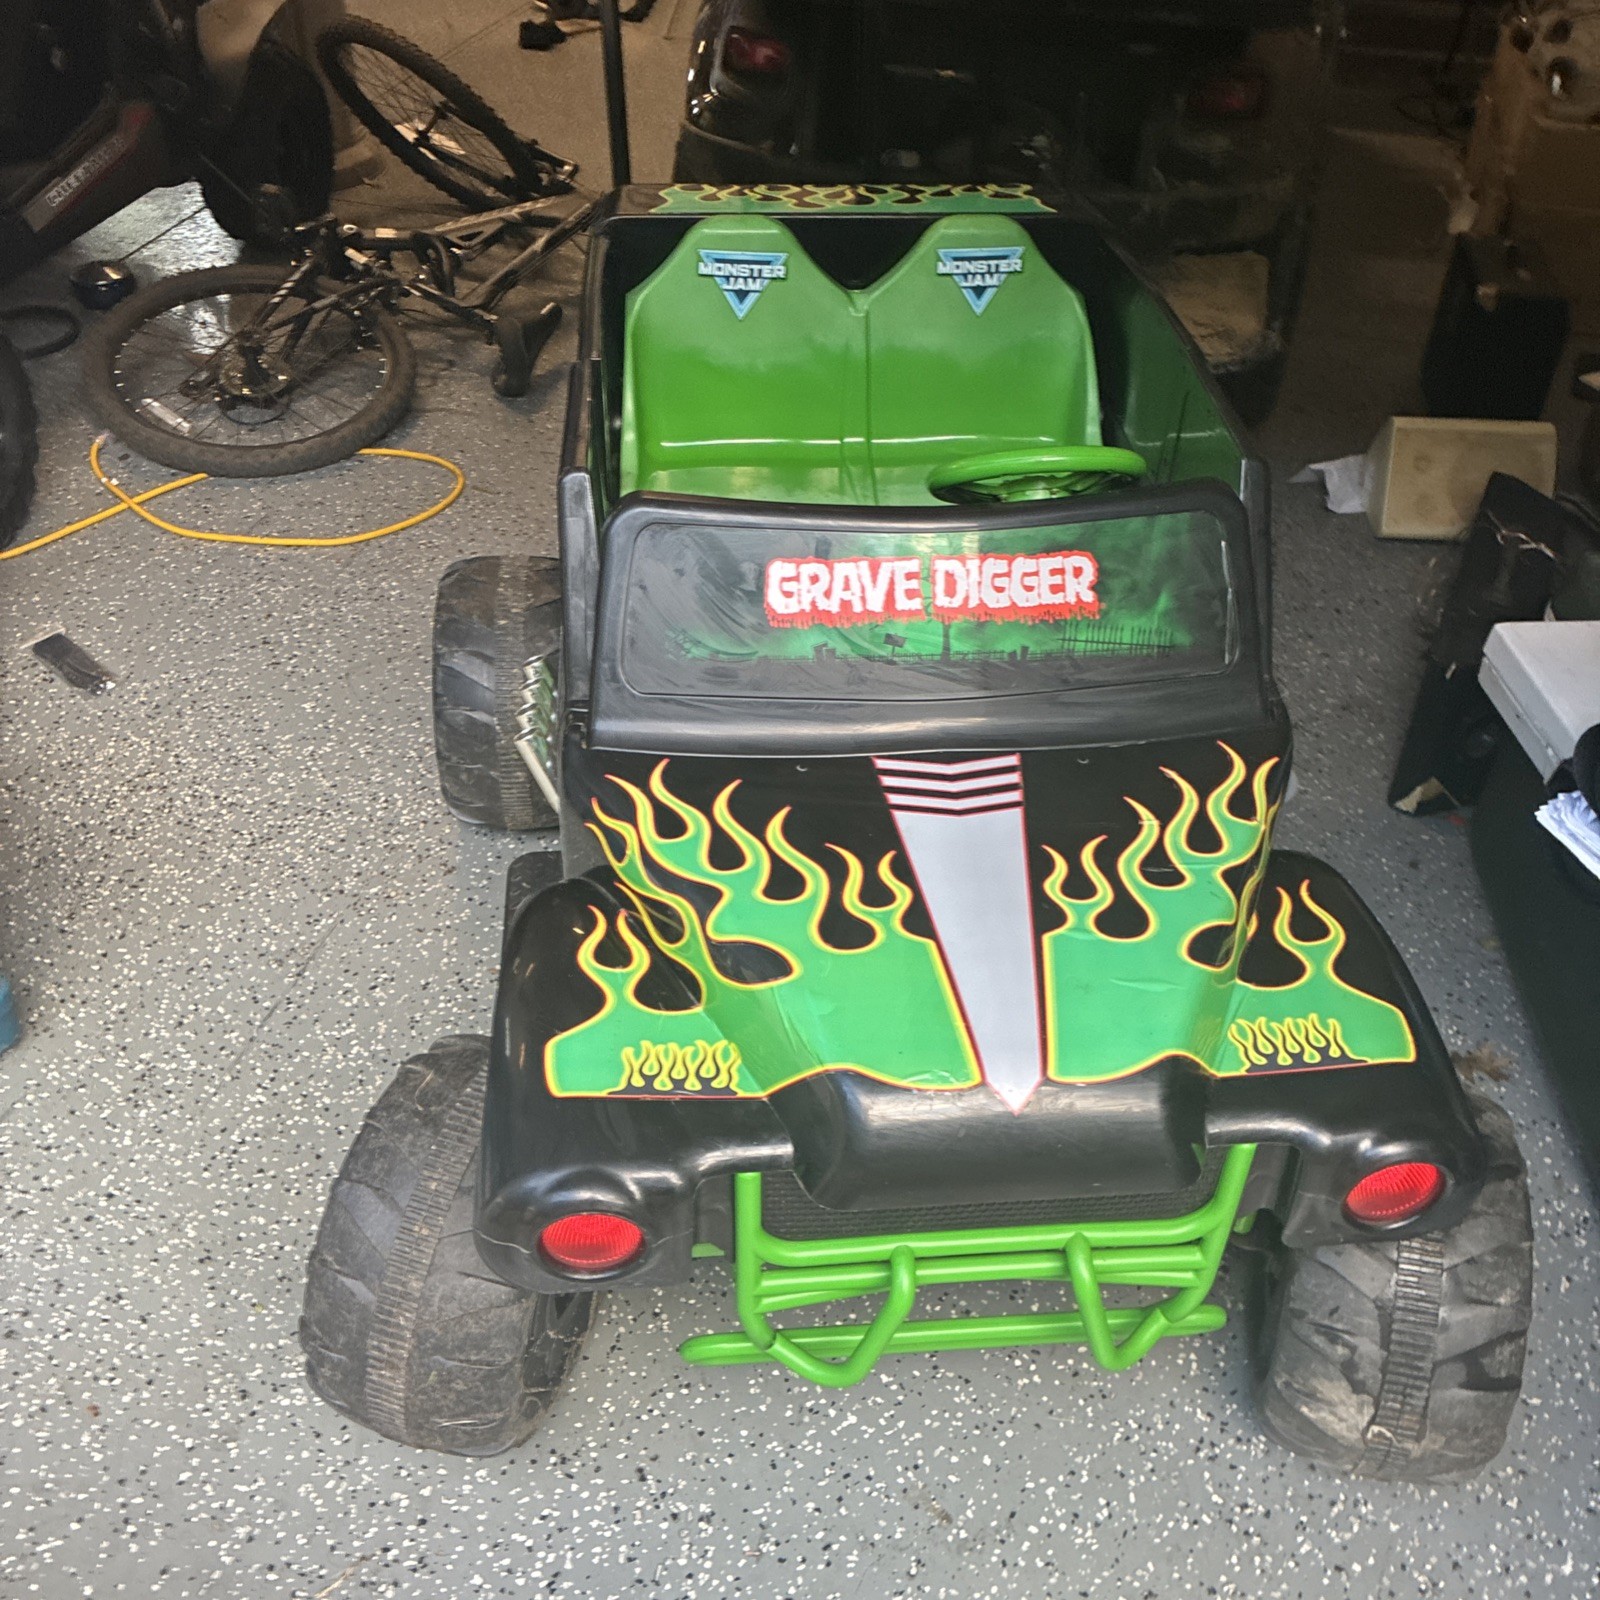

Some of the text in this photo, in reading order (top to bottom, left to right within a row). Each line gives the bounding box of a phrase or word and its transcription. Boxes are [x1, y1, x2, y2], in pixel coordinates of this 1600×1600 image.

[698, 261, 787, 279] MONSTER
[937, 258, 1023, 274] MONSTER
[721, 277, 763, 291] JAM
[960, 273, 1001, 287] JAM
[765, 554, 1098, 615] GRAVE DIGGER
